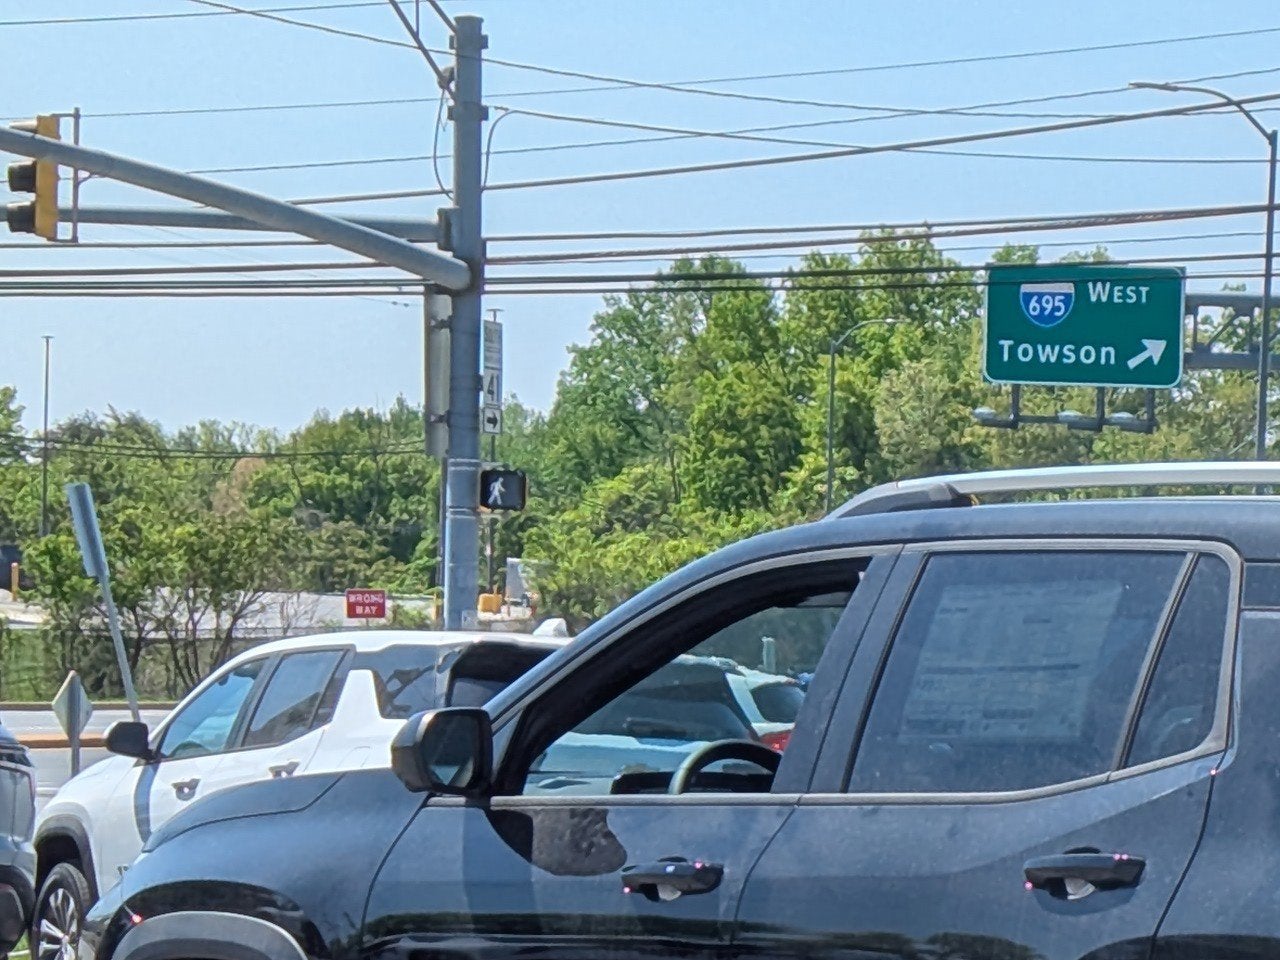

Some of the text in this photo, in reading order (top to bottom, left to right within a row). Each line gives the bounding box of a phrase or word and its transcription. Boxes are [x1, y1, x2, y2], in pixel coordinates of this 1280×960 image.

[1028, 281, 1150, 317] 695 WEST
[999, 339, 1116, 365] Towson
[348, 592, 384, 603] WRONG
[355, 605, 378, 615] WAY
